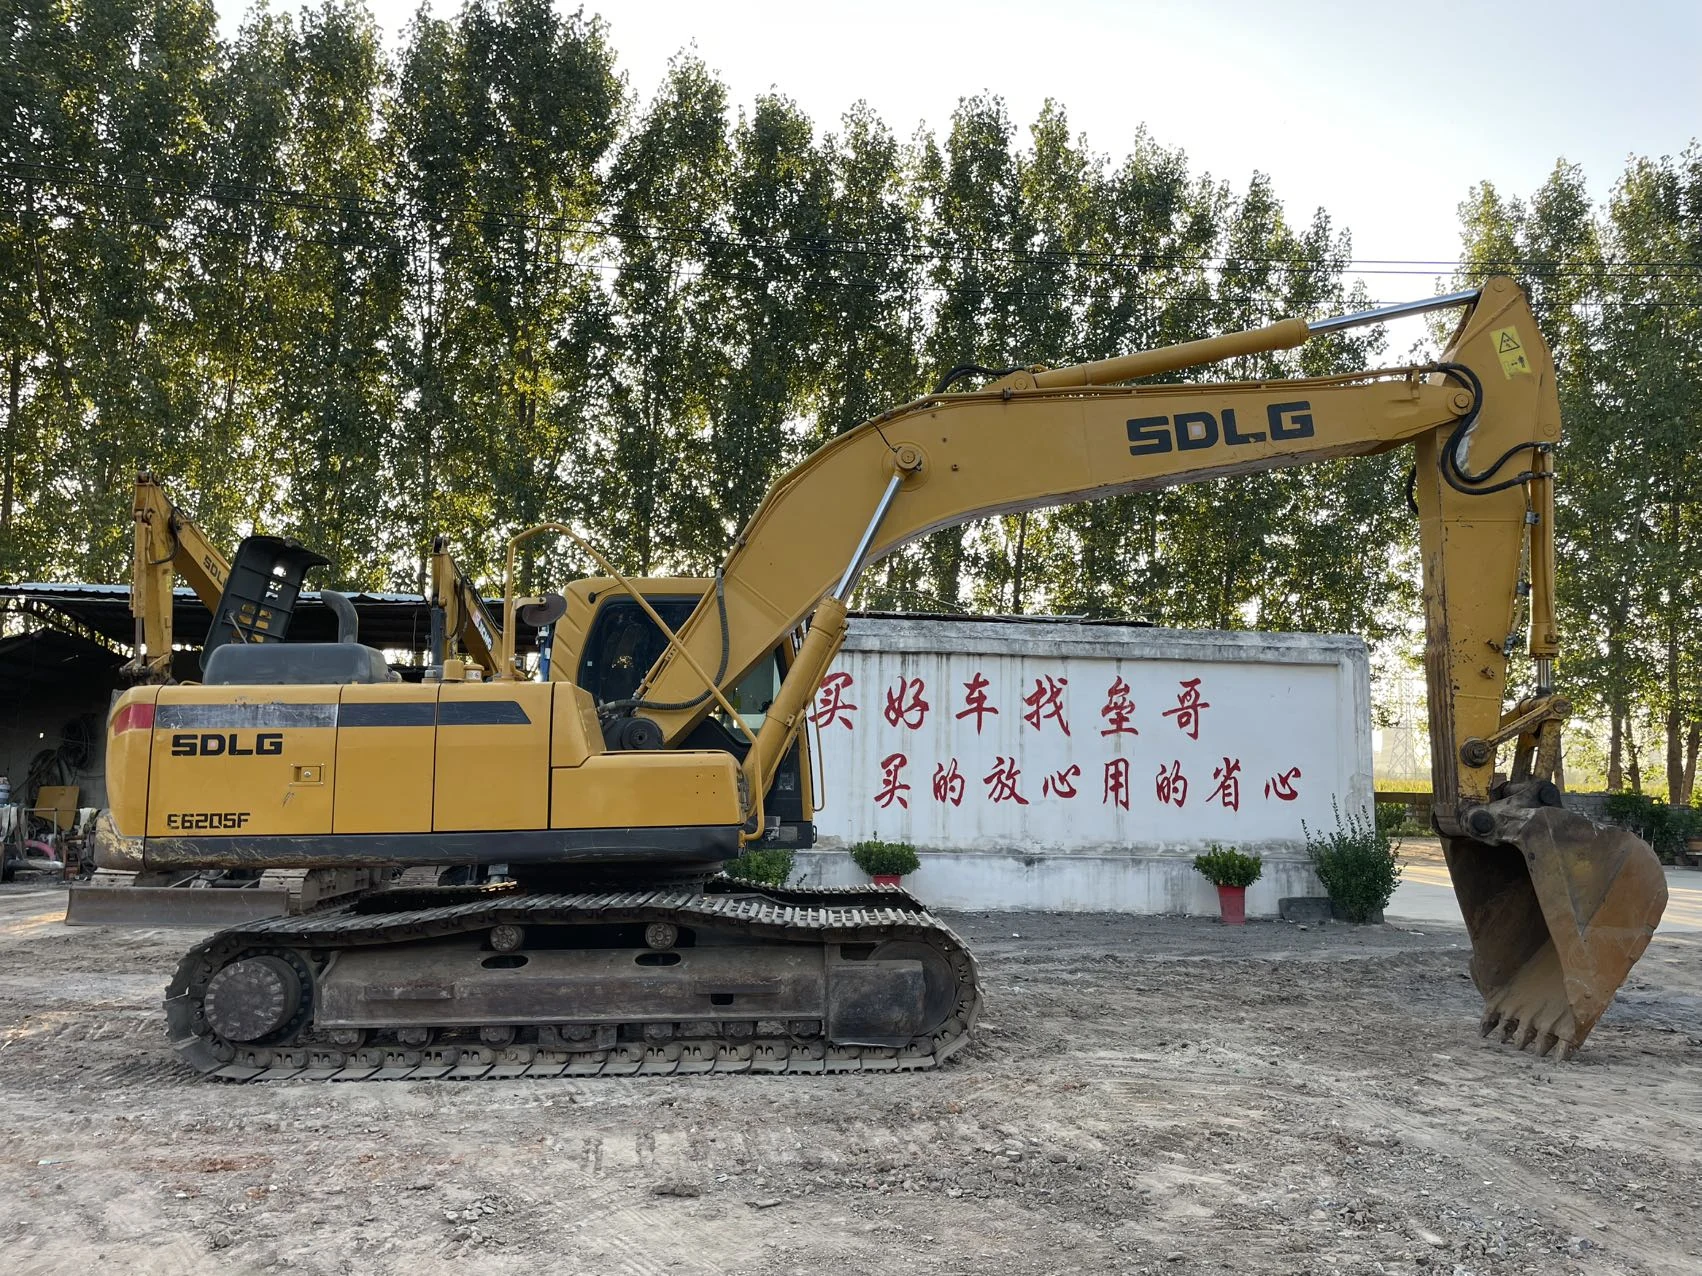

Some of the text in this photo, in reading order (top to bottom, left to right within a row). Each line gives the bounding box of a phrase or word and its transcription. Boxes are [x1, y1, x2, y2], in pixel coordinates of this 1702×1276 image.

[1127, 401, 1314, 456] SDLG
[204, 554, 227, 588] SDL
[172, 733, 283, 756] SDLG
[874, 753, 1301, 812] 买的放心用的省心
[167, 813, 250, 829] E6205F
